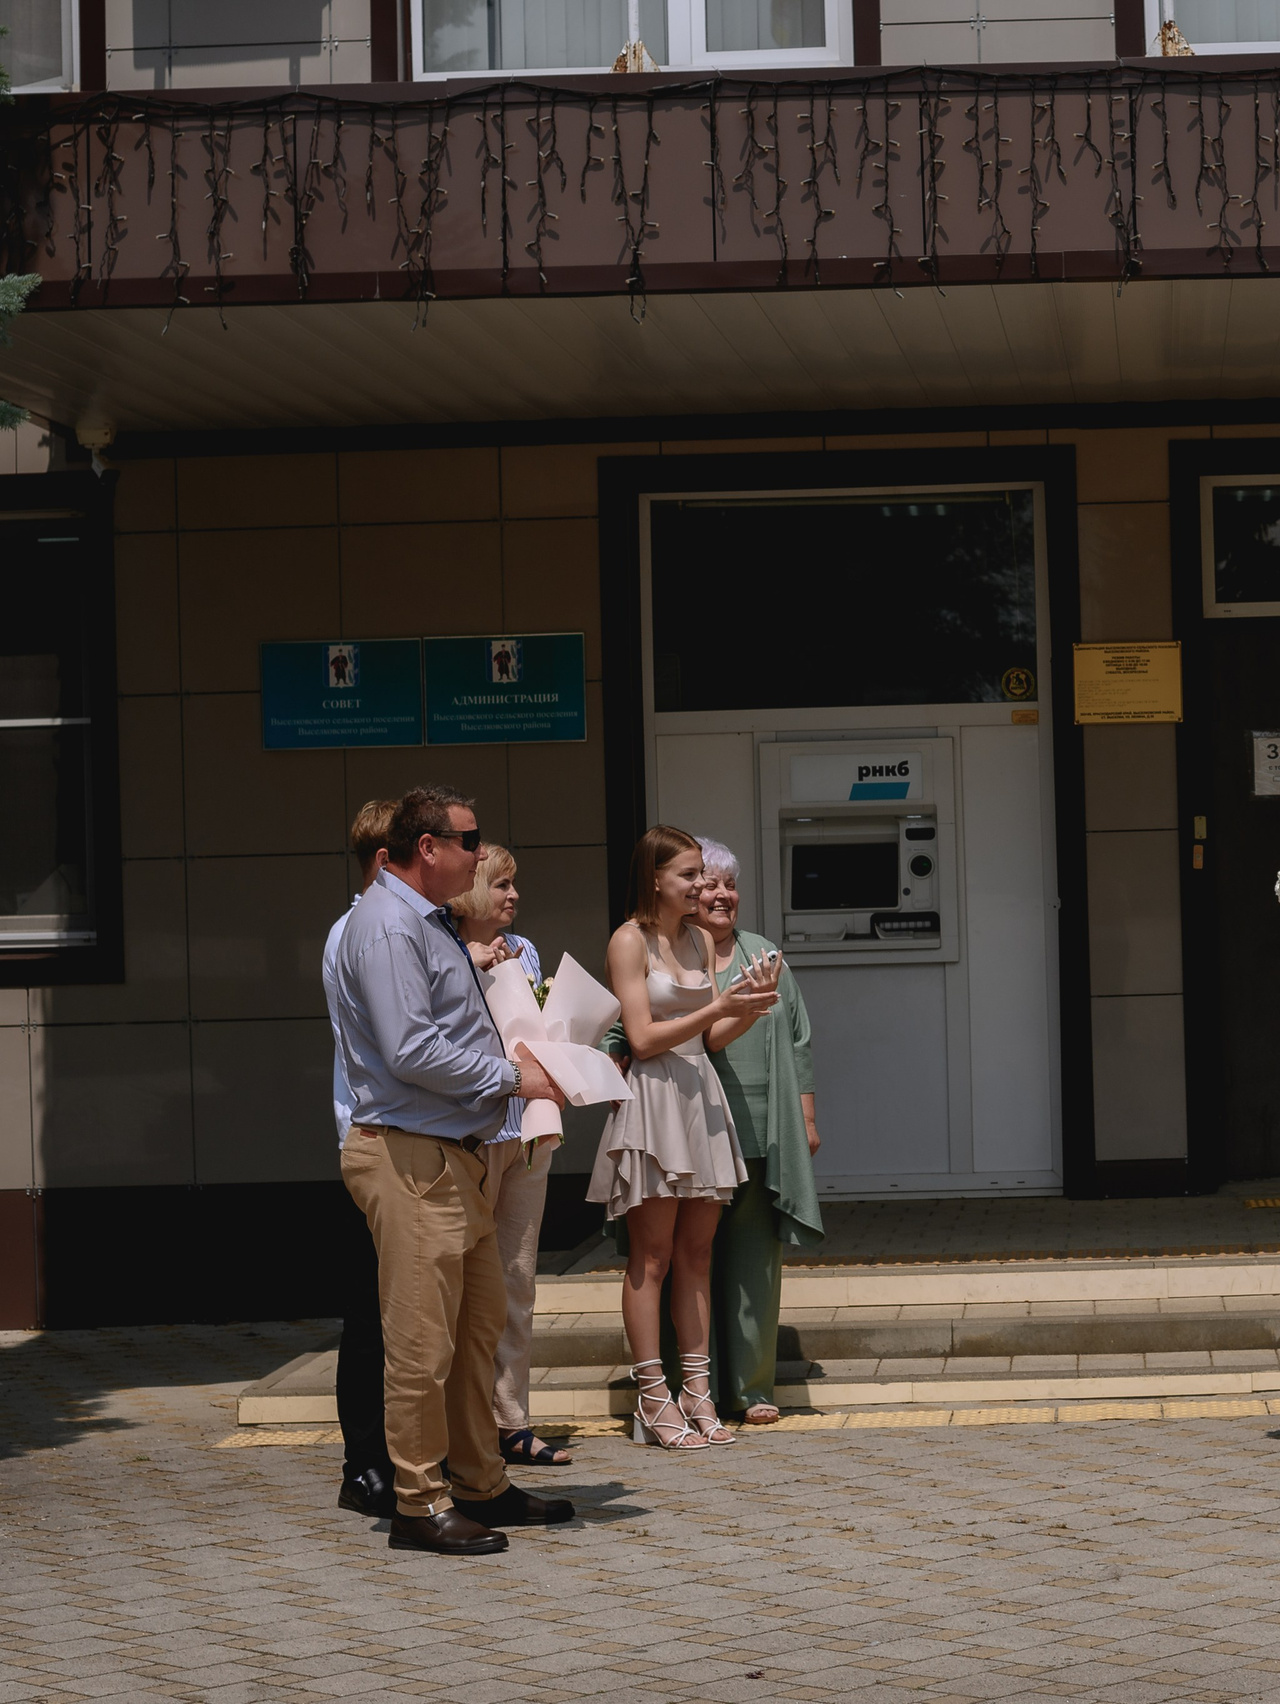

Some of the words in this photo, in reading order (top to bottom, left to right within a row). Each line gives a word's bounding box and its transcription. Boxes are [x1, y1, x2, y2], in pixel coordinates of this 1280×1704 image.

[322, 699, 361, 709] СОВЕТ
[451, 693, 559, 706] АДМИНИСТРАЦИЯ
[360, 726, 388, 735] района
[523, 721, 552, 730] района
[857, 760, 910, 781] рнкб
